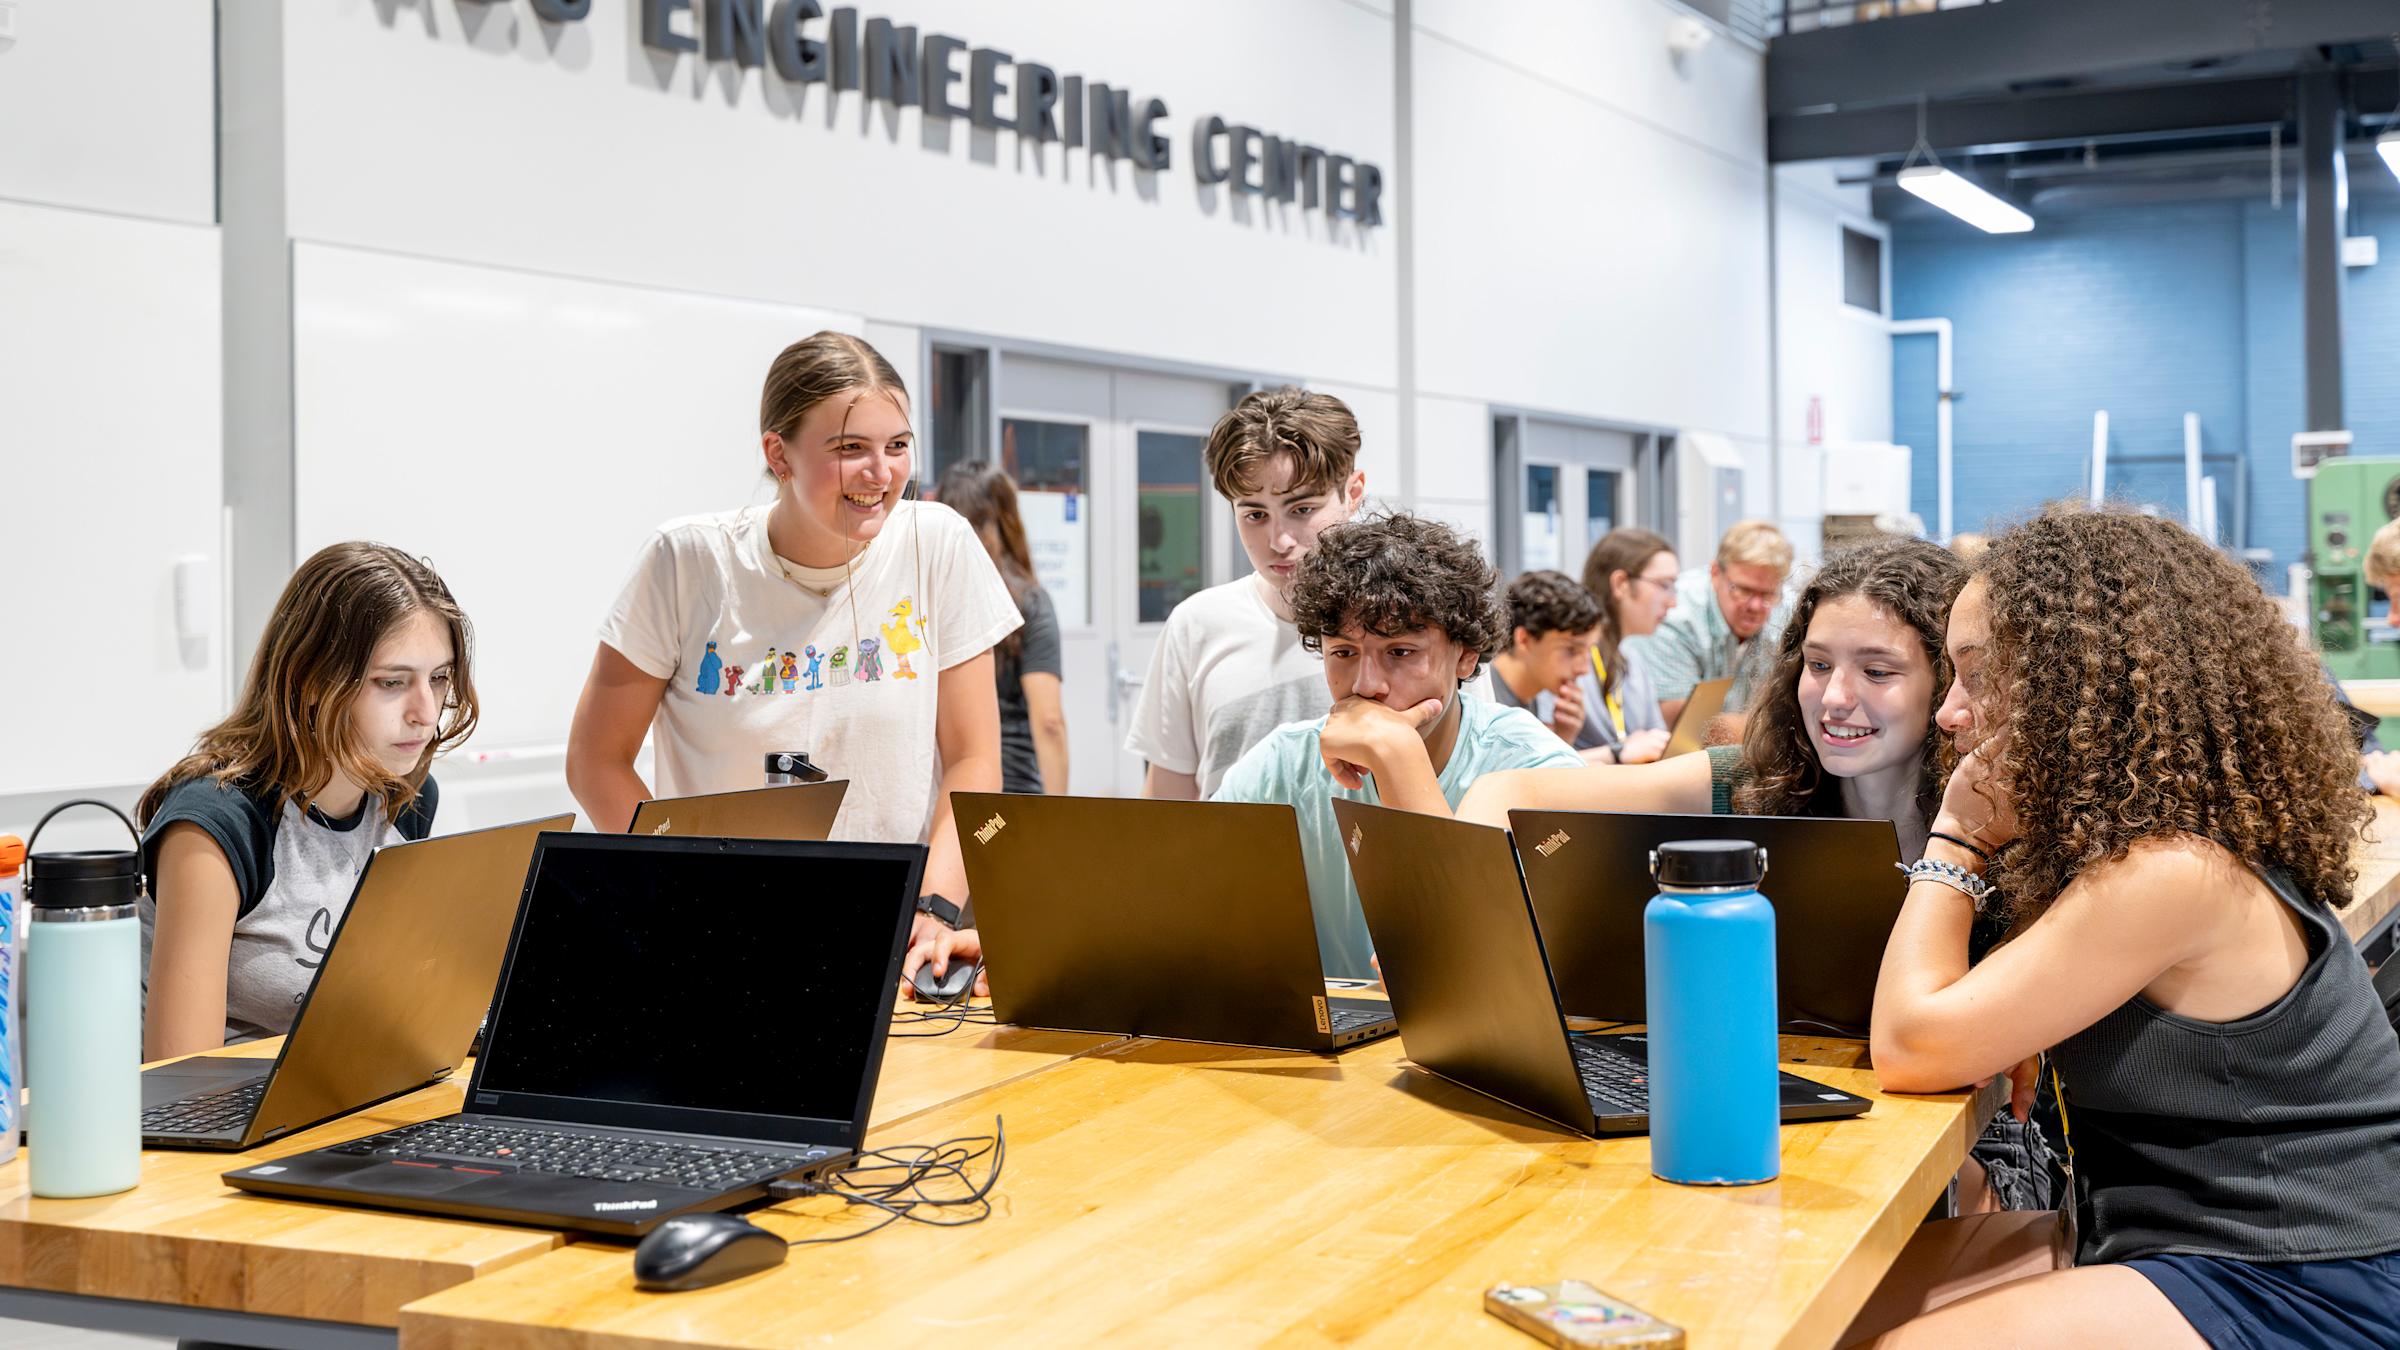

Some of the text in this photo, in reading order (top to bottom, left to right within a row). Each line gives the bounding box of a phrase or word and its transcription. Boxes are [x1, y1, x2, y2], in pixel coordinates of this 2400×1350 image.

[641, 0, 1383, 227] ENGINEERING CENTER
[973, 812, 1007, 845] ThinkPad
[1535, 828, 1571, 857] ThinkPad
[1317, 998, 1328, 1031] Lenovo
[593, 1199, 658, 1212] ThinkPad
